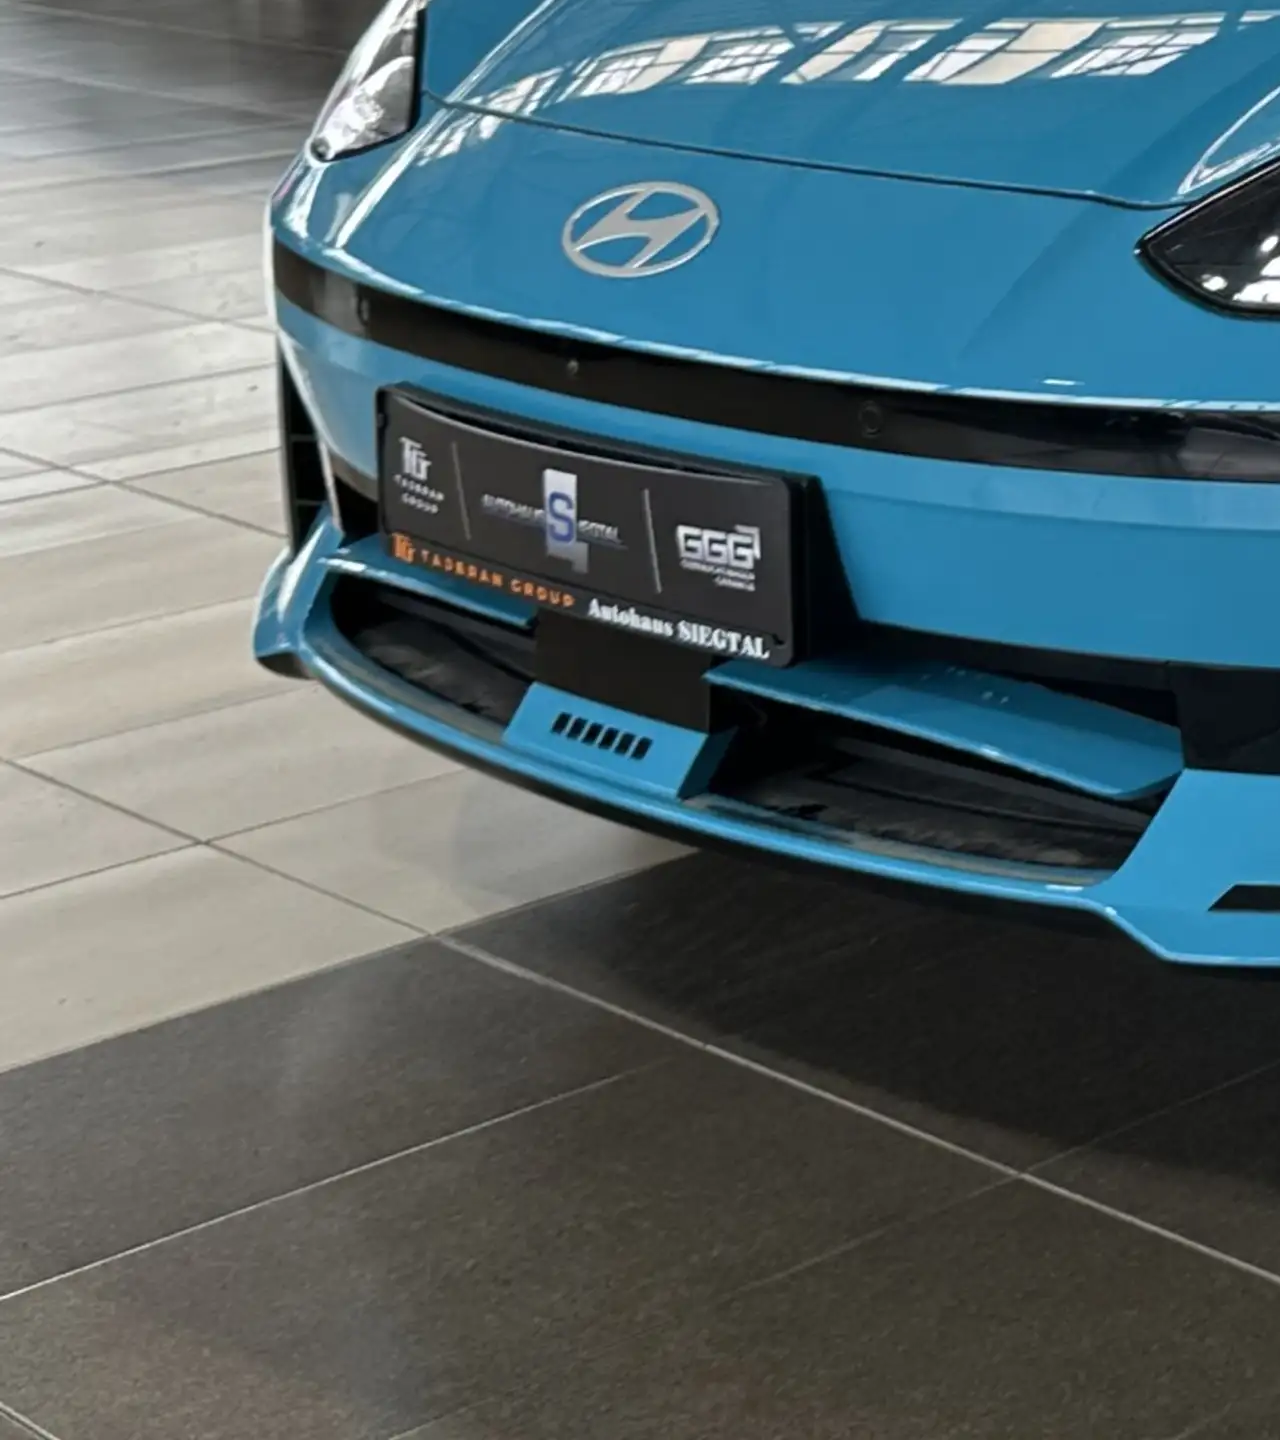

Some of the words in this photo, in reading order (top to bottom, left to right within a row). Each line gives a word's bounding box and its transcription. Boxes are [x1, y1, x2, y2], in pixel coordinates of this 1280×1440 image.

[510, 578, 575, 608] GROUP
[588, 597, 674, 637] Autohaus
[676, 619, 770, 659] SIEGTAL
